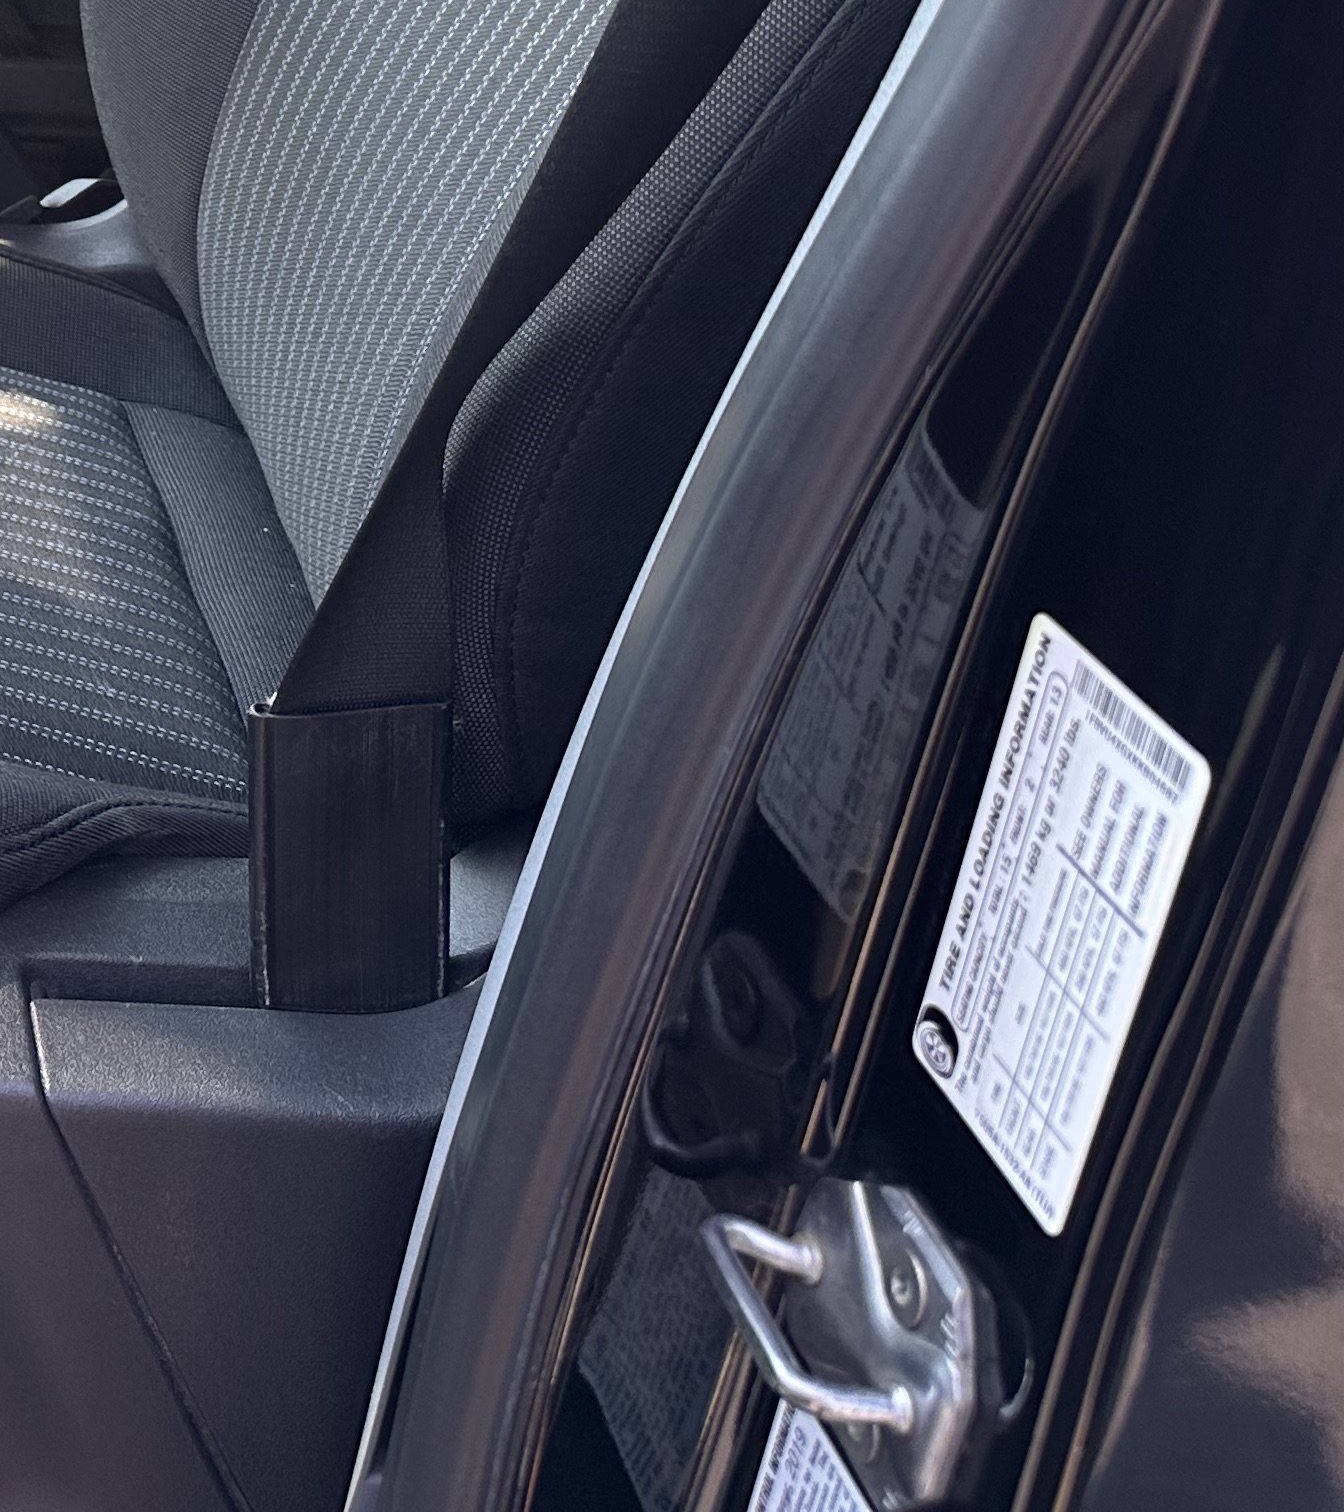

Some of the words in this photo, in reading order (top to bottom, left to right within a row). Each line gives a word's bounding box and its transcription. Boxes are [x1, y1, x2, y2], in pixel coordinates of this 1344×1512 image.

[1065, 713, 1081, 746] lbs.
[1001, 853, 1012, 875] 15
[1025, 777, 1035, 791] 2
[1050, 685, 1062, 707] 13
[1050, 745, 1071, 793] 3240
[940, 940, 961, 994] TIRE
[955, 891, 976, 940] AND
[970, 792, 1005, 890] LOADING
[1000, 633, 1052, 789] INFORMATION
[1045, 795, 1057, 815] or
[1071, 829, 1087, 859] SEE
[1081, 763, 1107, 828] OWNERS
[1110, 780, 1126, 813] FOR
[1036, 816, 1052, 843] kg
[1022, 840, 1041, 887] 1469
[1127, 812, 1168, 918] INFORMATION
[785, 1426, 806, 1480] 2019
